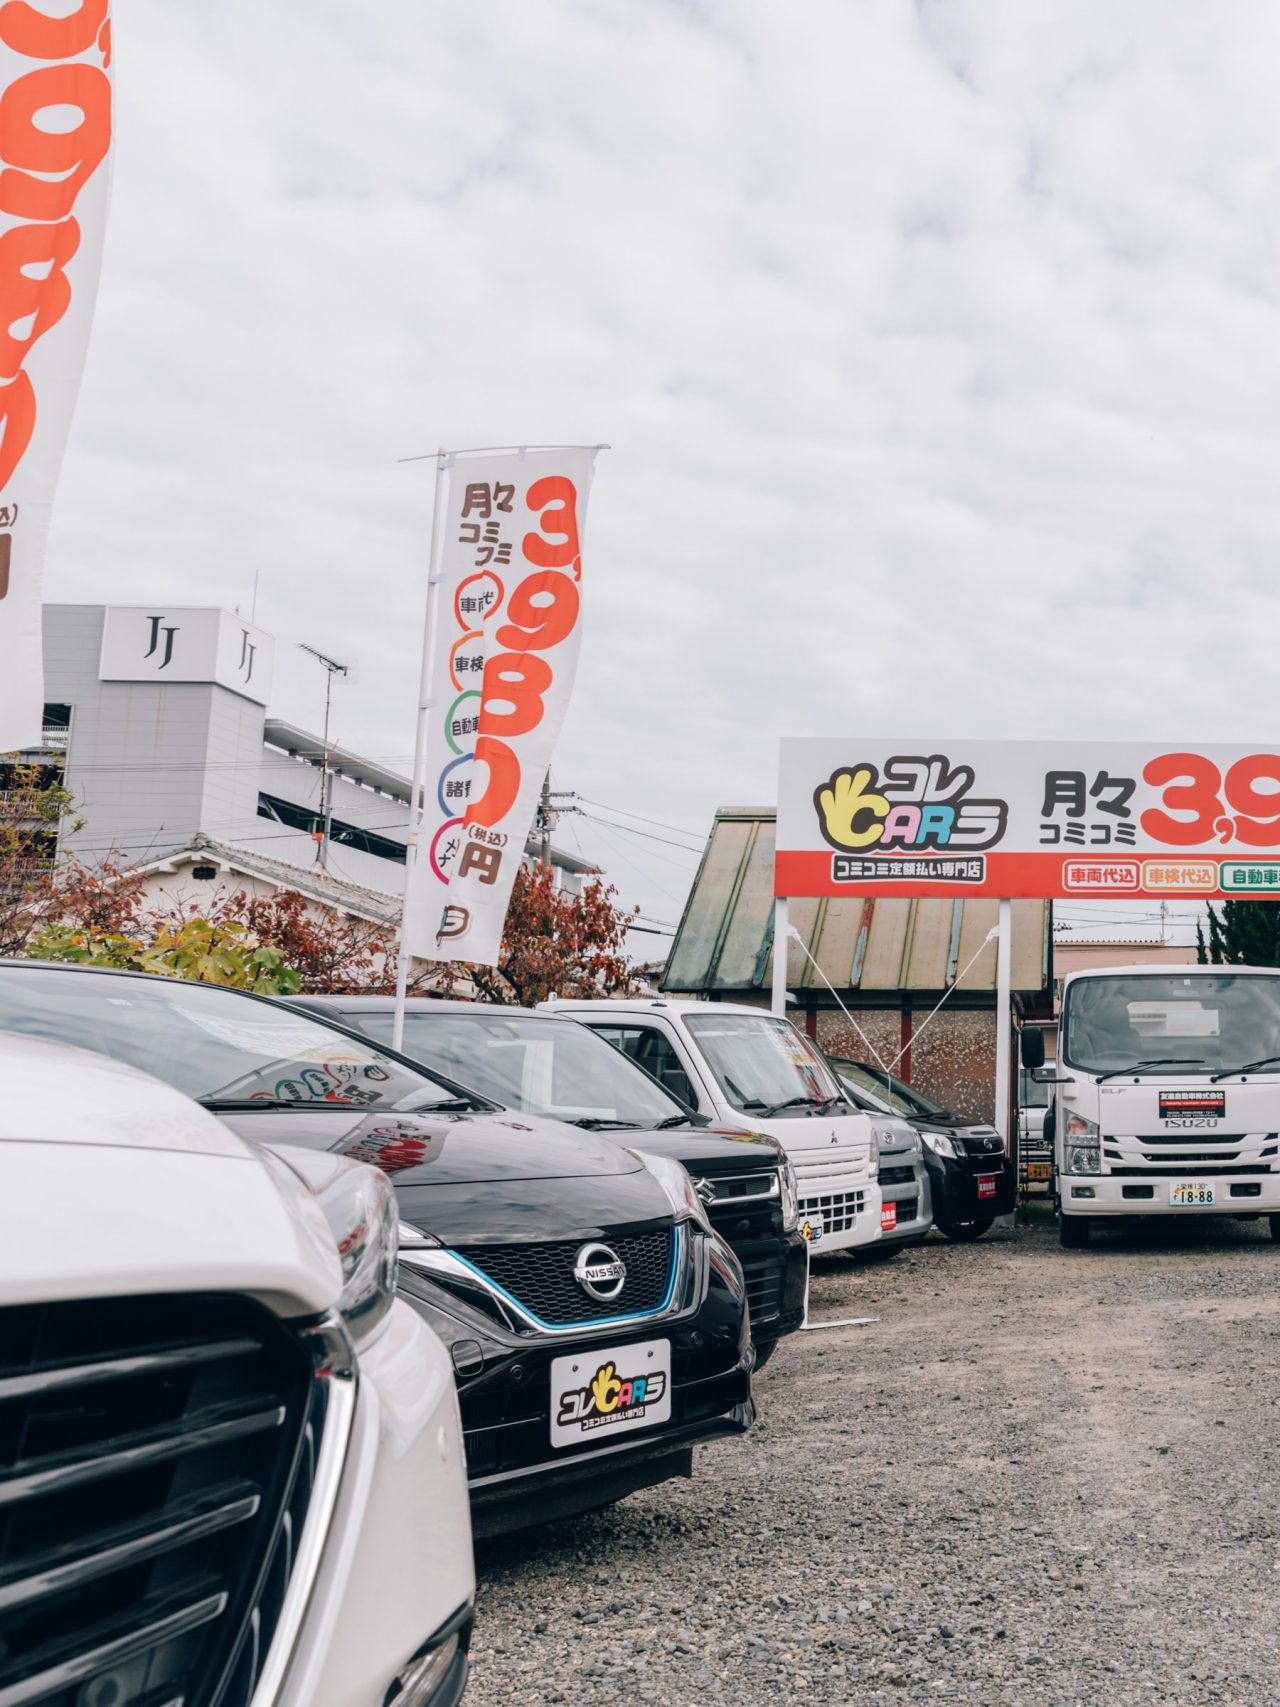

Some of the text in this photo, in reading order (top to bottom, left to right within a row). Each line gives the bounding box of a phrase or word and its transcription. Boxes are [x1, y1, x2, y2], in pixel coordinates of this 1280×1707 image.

[1041, 770, 1137, 818] 月々
[1039, 822, 1137, 846] コミコミ
[458, 842, 502, 885] 円
[836, 861, 981, 878] コミコミ定額払い専門店
[1070, 867, 1134, 884] 車両代込
[1148, 868, 1212, 885] 車検代込
[1164, 1119, 1218, 1128] ISUZU
[1181, 1190, 1213, 1203] 18-88
[585, 1264, 626, 1279] NISSAN
